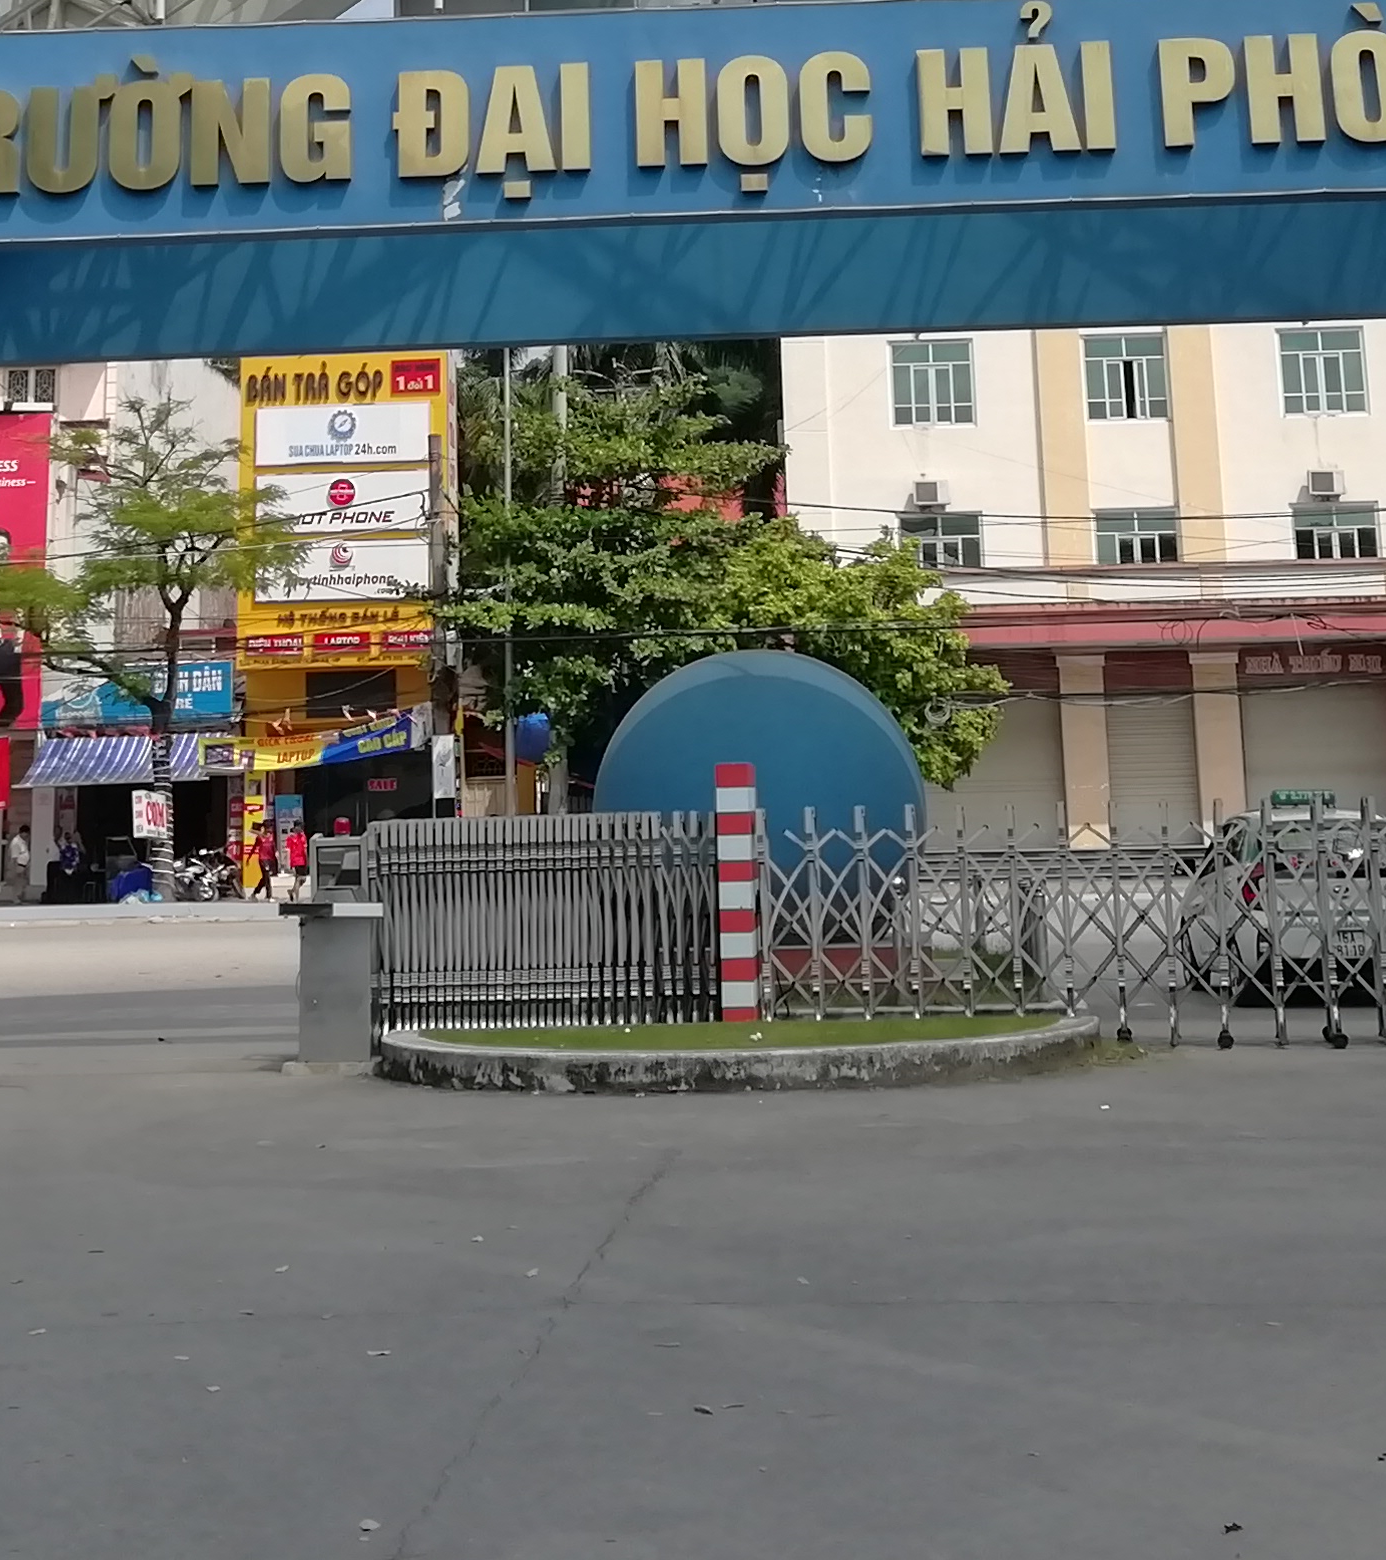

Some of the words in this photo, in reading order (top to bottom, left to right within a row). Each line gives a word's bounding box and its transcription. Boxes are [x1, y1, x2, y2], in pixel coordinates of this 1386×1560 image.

[392, 61, 592, 199] ĐẠI
[634, 50, 872, 192] HỌC
[915, 0, 1117, 157] HẢI
[246, 366, 287, 404] BÁN
[294, 361, 330, 402] TRẢ
[337, 362, 383, 400] GÓP
[396, 375, 405, 391] 1
[424, 374, 434, 390] 1
[329, 511, 395, 525] PHONE
[1245, 651, 1284, 674] NHÀ
[193, 665, 223, 692] DÂN
[276, 749, 315, 764] LAPTOP
